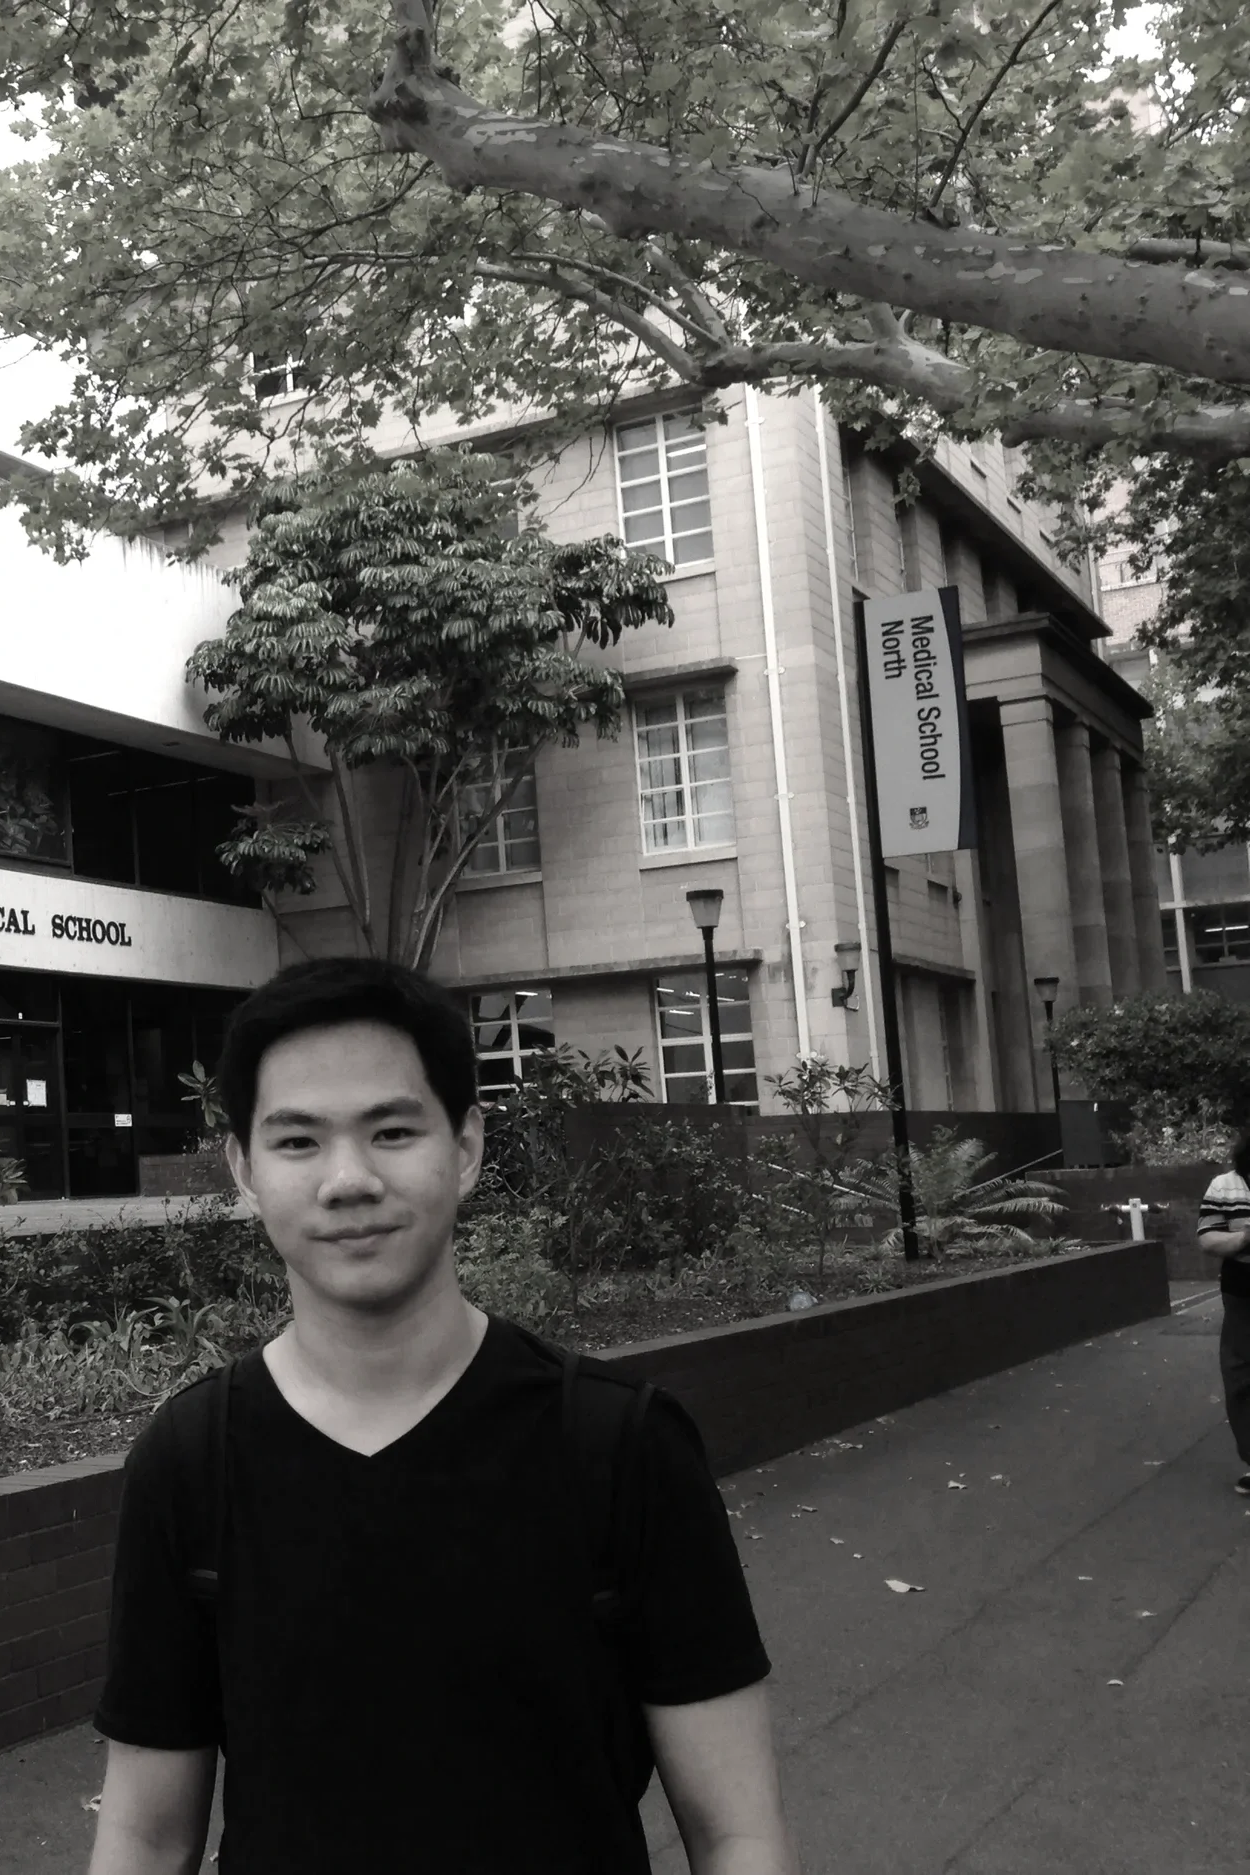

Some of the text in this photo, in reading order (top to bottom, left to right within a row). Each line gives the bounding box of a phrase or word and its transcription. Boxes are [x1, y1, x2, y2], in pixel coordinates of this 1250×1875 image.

[881, 619, 908, 680] North
[910, 615, 946, 781] Medical School
[50, 914, 132, 947] SCHOOL
